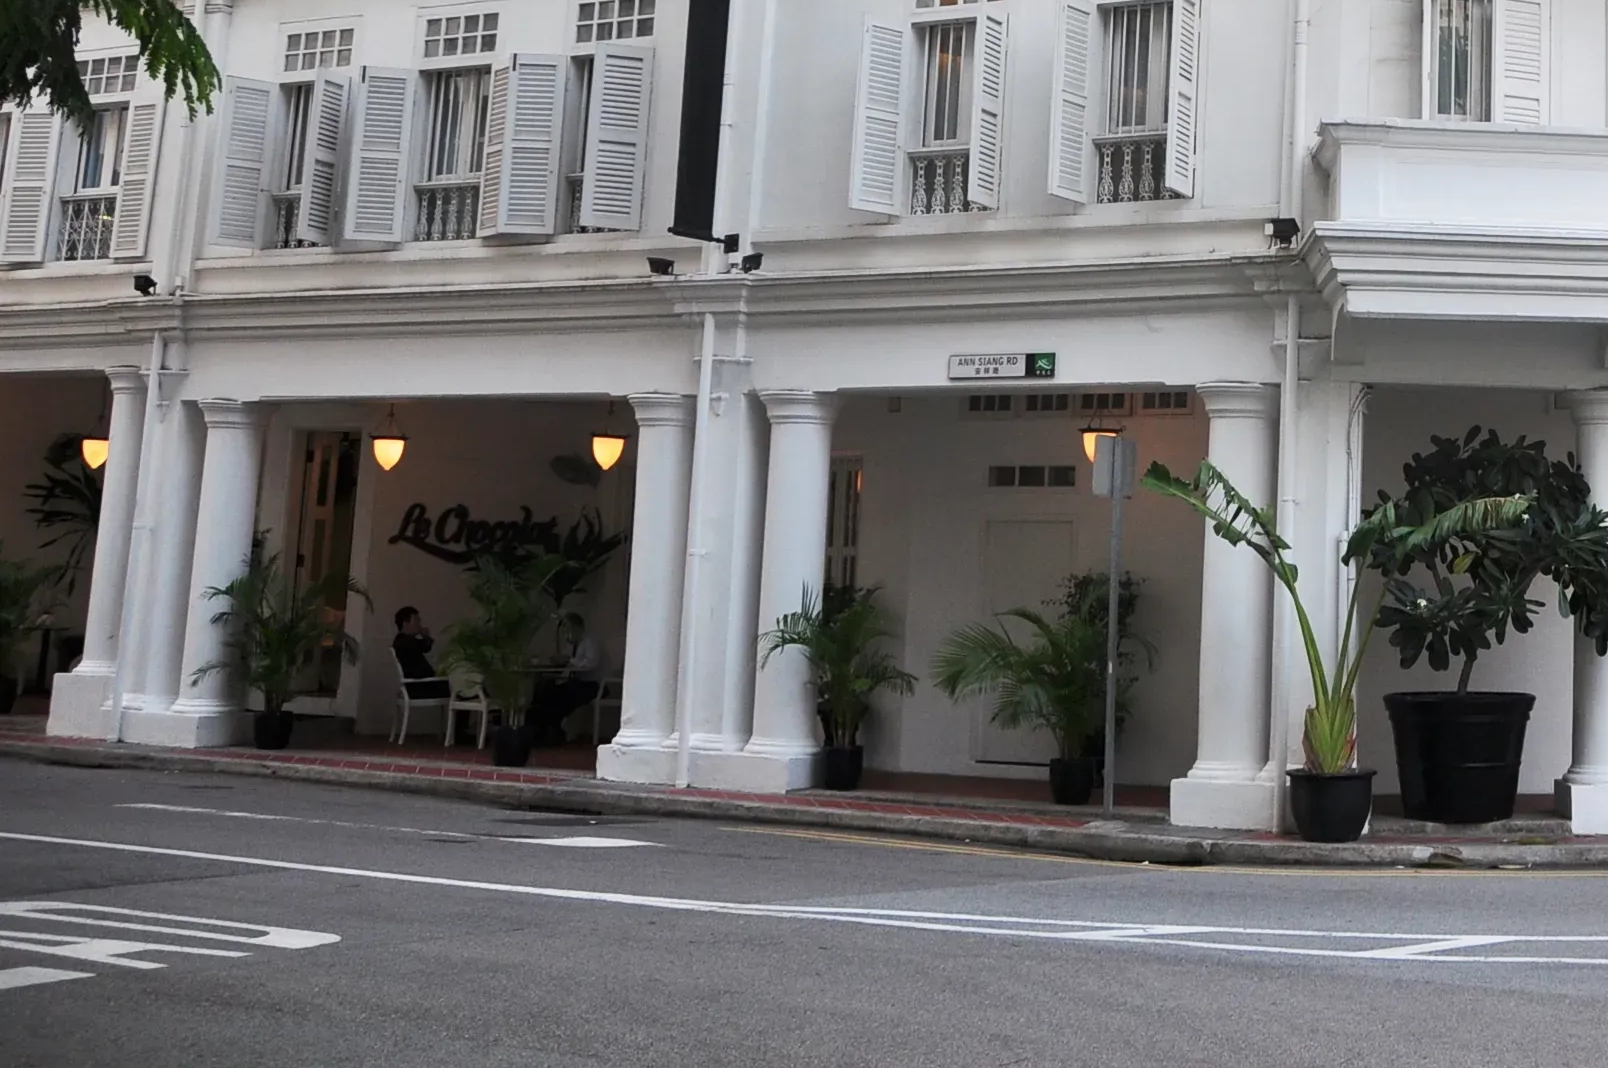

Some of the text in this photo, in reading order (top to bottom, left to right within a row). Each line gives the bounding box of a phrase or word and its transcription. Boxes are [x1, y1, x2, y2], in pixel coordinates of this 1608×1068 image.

[957, 356, 1018, 367] ANN SIANG RD
[388, 502, 432, 544] Le
